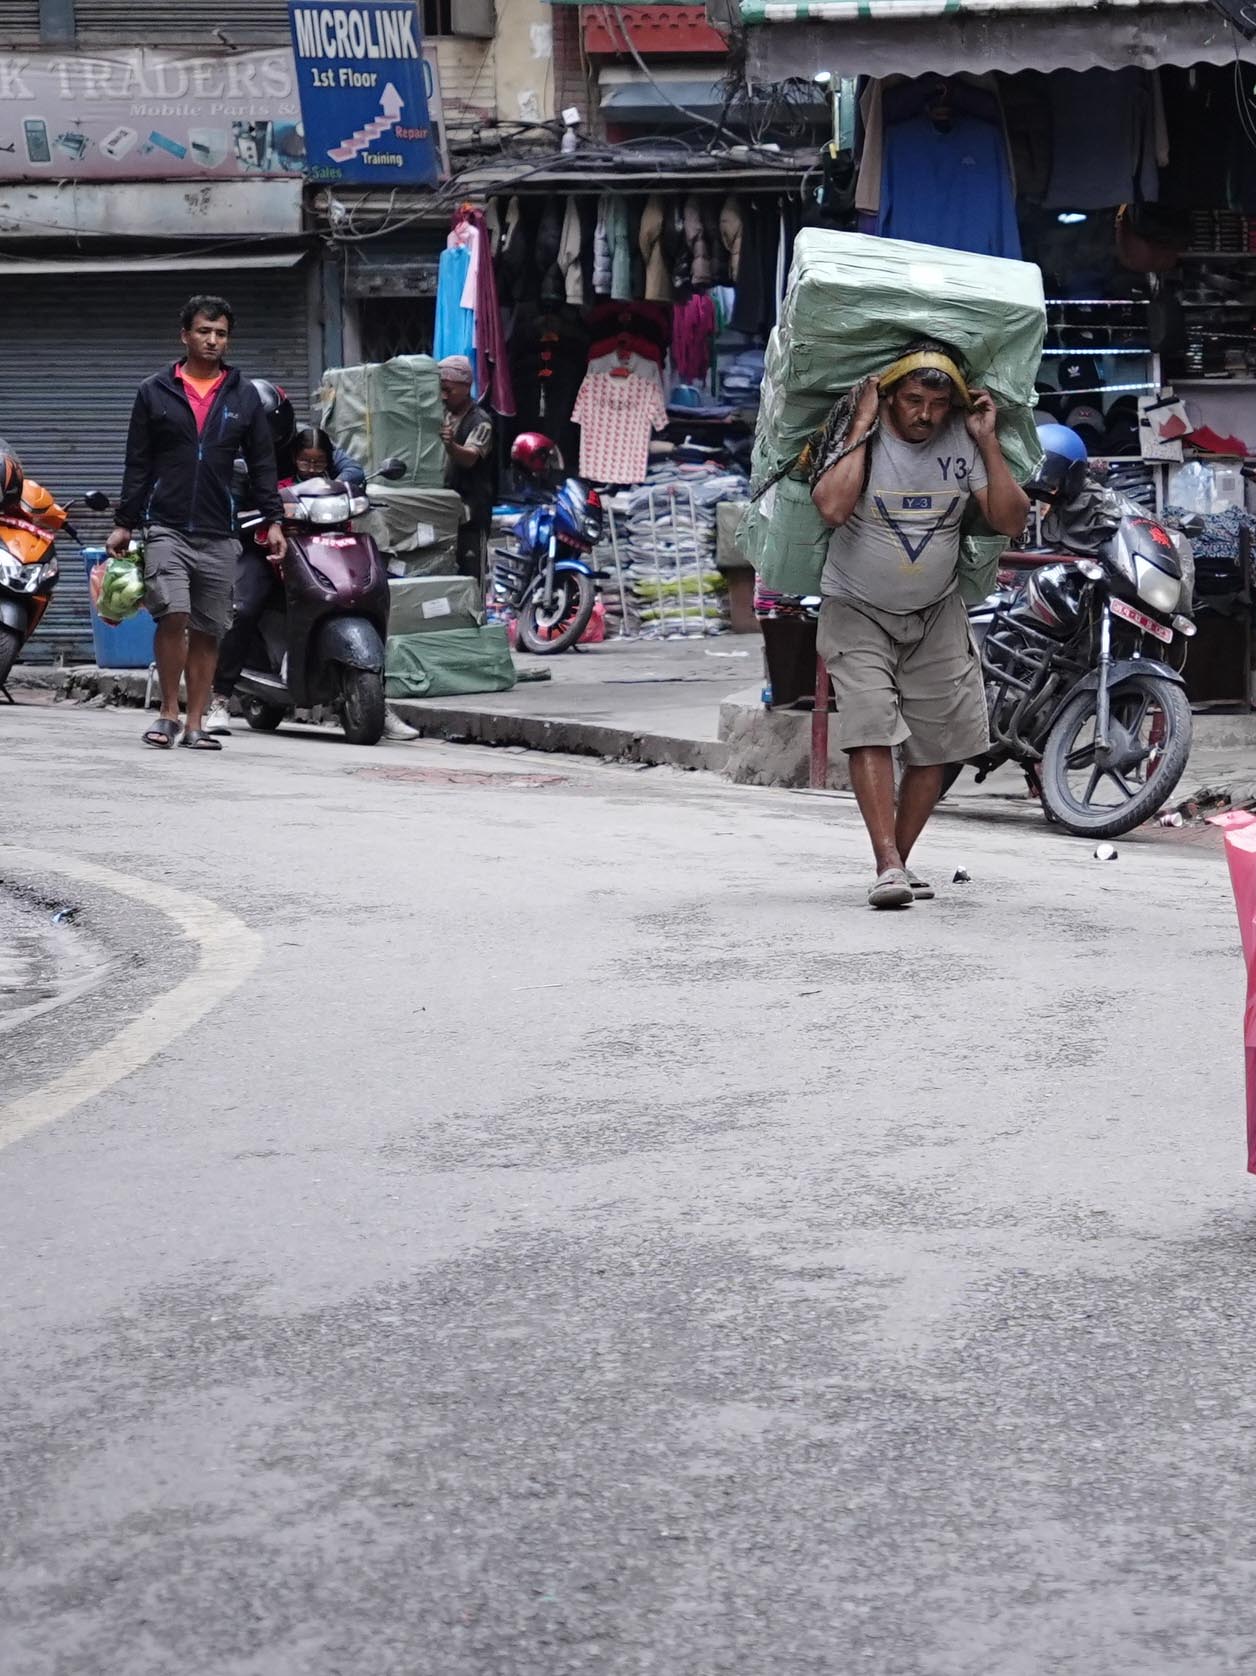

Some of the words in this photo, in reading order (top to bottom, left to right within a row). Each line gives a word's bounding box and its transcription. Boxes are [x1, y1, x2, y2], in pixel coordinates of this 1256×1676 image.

[294, 9, 418, 59] MICROLINK
[48, 57, 292, 99] TRADERS
[311, 68, 335, 87] 1st
[339, 68, 377, 87] Floor
[130, 103, 200, 117] Mobile
[210, 103, 269, 116] Parts
[395, 126, 428, 140] Repair
[361, 152, 403, 167] Training
[311, 166, 342, 179] Sales
[906, 498, 928, 508] Y-3
